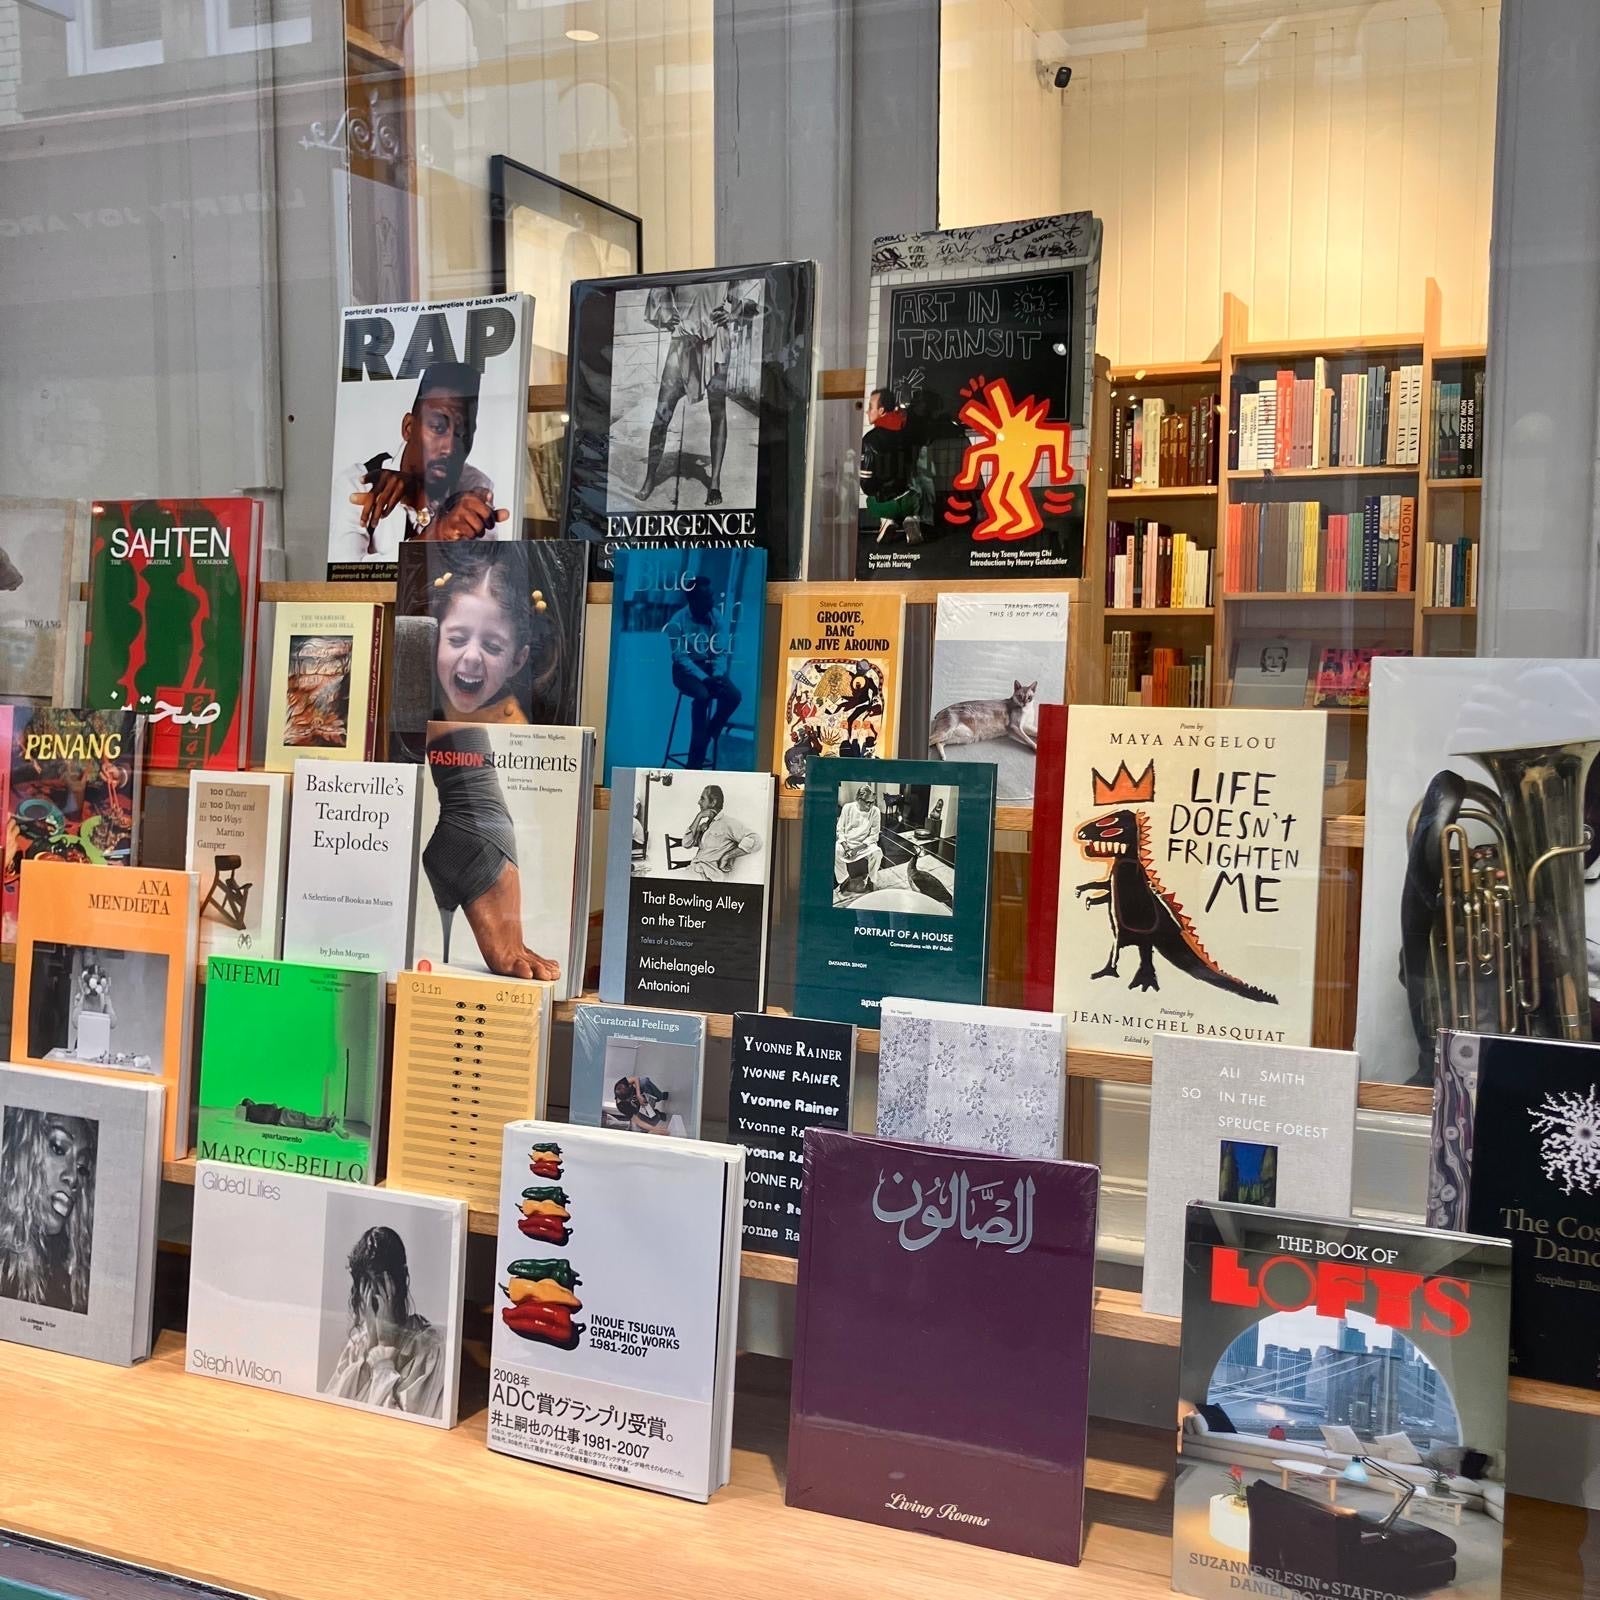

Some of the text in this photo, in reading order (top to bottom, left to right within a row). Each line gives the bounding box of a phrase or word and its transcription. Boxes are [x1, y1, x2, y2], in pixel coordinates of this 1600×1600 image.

[900, 289, 1001, 324] ART IN
[341, 307, 516, 383] RAP
[897, 328, 1042, 362] TRANSIT
[605, 513, 756, 538] EMERGENCE
[1401, 503, 1413, 548] NICOLA
[110, 527, 232, 558] SAHTEN
[868, 560, 912, 570] by Keith Haring
[869, 552, 921, 562] Subway Drawings
[970, 550, 1052, 560] Photos by Tseng Kwong Chi
[970, 557, 1068, 567] Introduction by Henry Geldzahler
[632, 560, 697, 592] Blue
[718, 592, 743, 623] in
[819, 600, 864, 608] Steve Cannon
[817, 611, 864, 625] GROOVE,
[825, 624, 855, 637] BANG
[789, 638, 890, 651] AND JIVE AROUND
[25, 733, 122, 761] PENANG
[1110, 733, 1276, 749] MAYA ANGELOU
[225, 788, 247, 798] Chairs
[539, 785, 563, 794] Designers
[1191, 768, 1276, 806] LIFE
[224, 801, 255, 812] Days and
[315, 802, 390, 829] Teardrop
[224, 814, 242, 825] Ways
[216, 827, 245, 837] Martino
[313, 830, 389, 855] Explodes
[197, 839, 226, 852] Gamper
[1168, 838, 1299, 870] FRIGHTEN
[137, 880, 171, 896] ANA
[1205, 871, 1281, 913] ME
[88, 894, 170, 916] MENDIETA
[308, 892, 393, 907] Selection Books Muses
[642, 891, 745, 913] That Bowling Alley
[641, 913, 706, 929] on the Tiber
[640, 936, 694, 948] Tales of Director
[854, 927, 954, 943] PORTRAIT OF A HOUSE
[319, 947, 370, 960] by John Morgan
[210, 962, 281, 987] NIFEMI
[639, 956, 715, 976] Michelangelo
[411, 981, 442, 995] Clin
[638, 978, 690, 994] Antonioni
[593, 1014, 680, 1033] Curatorial Feelings
[1160, 1007, 1194, 1019] Paintings by
[1072, 1010, 1286, 1042] JEAN-MICHEL BASQUIAT
[1124, 1035, 1142, 1044] Edited
[742, 1066, 840, 1088] YVONNE RAINER
[1219, 1066, 1305, 1086] ALI SMITH
[740, 1091, 840, 1117] Yvonne Rainer
[1181, 1087, 1267, 1107] SO IN THE
[738, 1117, 786, 1135] Yvonne
[1218, 1115, 1329, 1139] SPRUCE FOREST
[262, 1132, 302, 1144] apartamento
[201, 1141, 364, 1184] MARCUS-BELLO
[202, 1171, 281, 1201] Gilded Lilies
[1500, 1207, 1549, 1234] The
[1277, 1235, 1399, 1265] THE BOOK OF
[1210, 1246, 1471, 1337] LOFTS
[591, 1314, 676, 1338] INOUE TSUGUYA
[590, 1326, 680, 1350] GRAPHIC WORKS
[590, 1338, 648, 1357] 1981-2007
[192, 1349, 282, 1384] Steph Wilson
[493, 1368, 530, 1388] 2008年
[491, 1409, 580, 1446] 井上嗣也の仕事
[582, 1433, 650, 1460] 1981-2007
[885, 1492, 990, 1527] Living Rooms
[1189, 1553, 1263, 1576] SUZANNE
[1264, 1568, 1320, 1591] SLESIN
[1230, 1575, 1287, 1599] DANIEL
